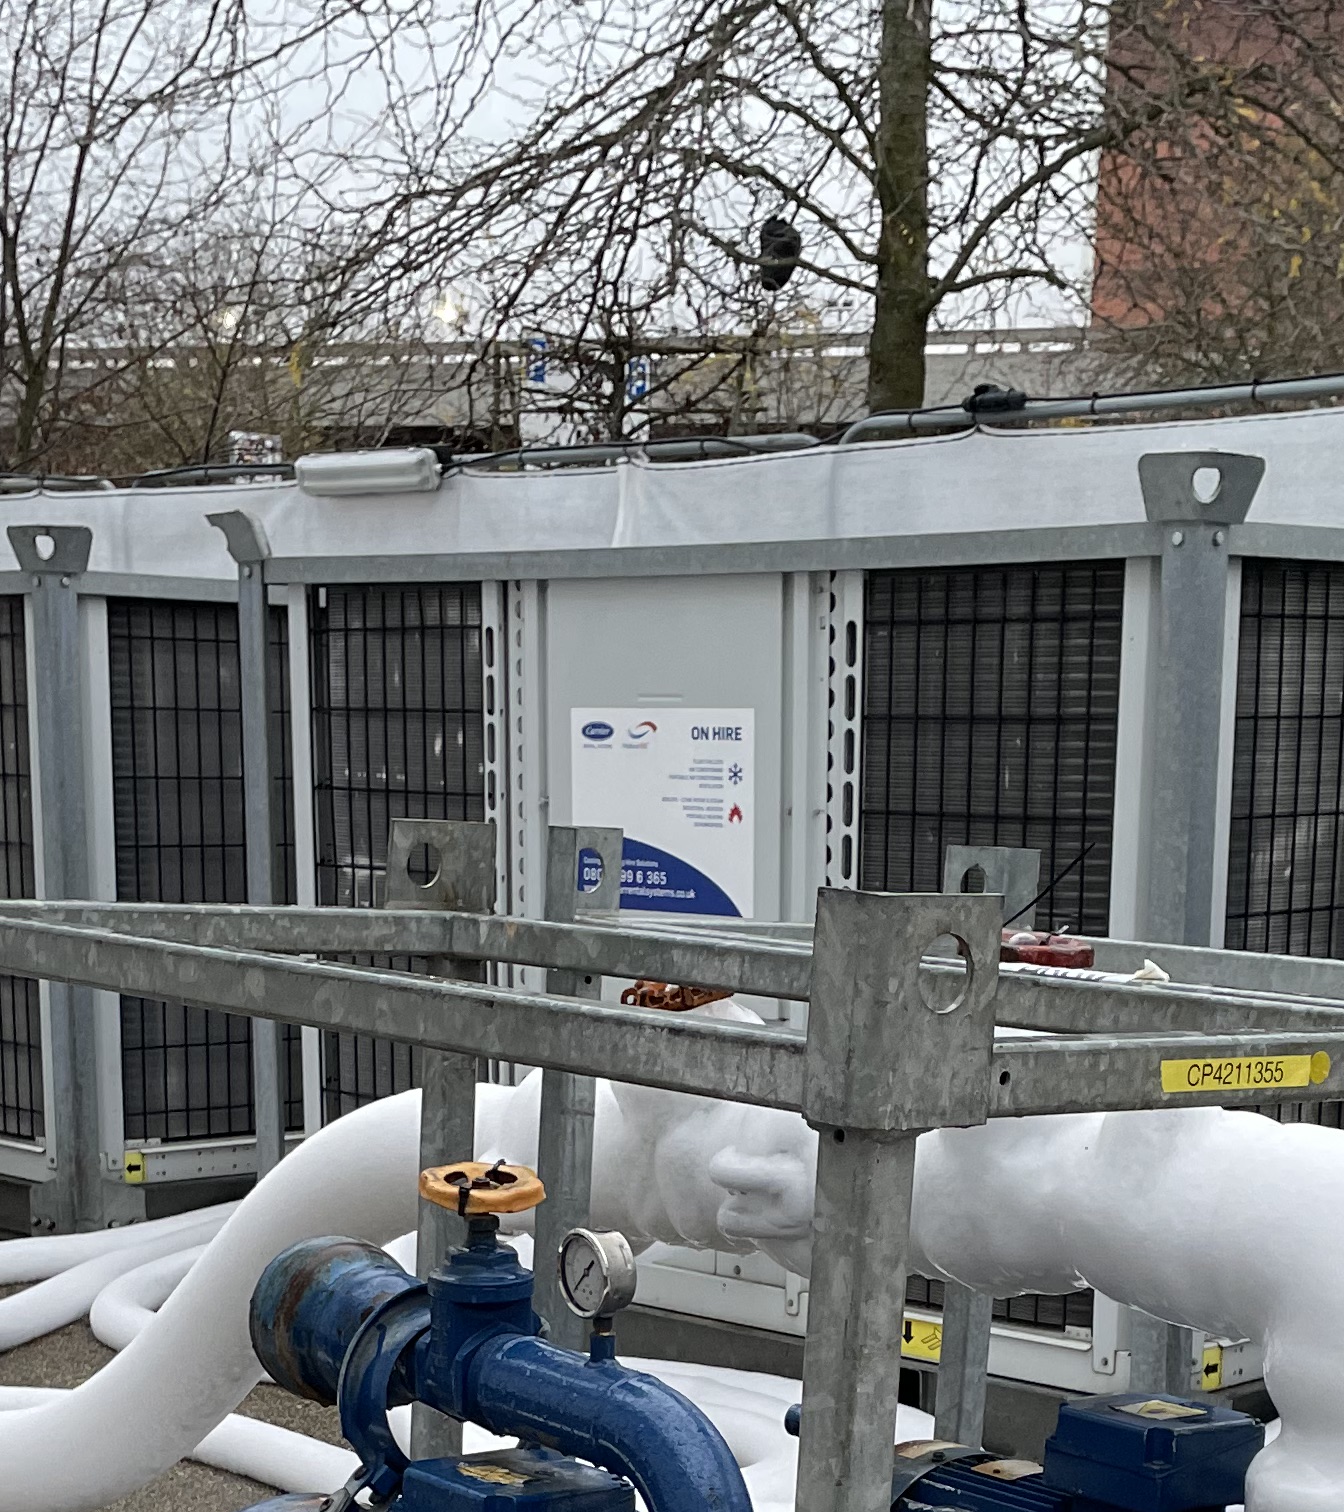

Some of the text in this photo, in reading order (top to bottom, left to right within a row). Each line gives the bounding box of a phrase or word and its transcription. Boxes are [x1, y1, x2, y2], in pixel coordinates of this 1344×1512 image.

[691, 727, 743, 741] ON HIRE
[636, 870, 644, 884] 6
[646, 872, 668, 885] 365
[1187, 1060, 1285, 1087] CP4211355
